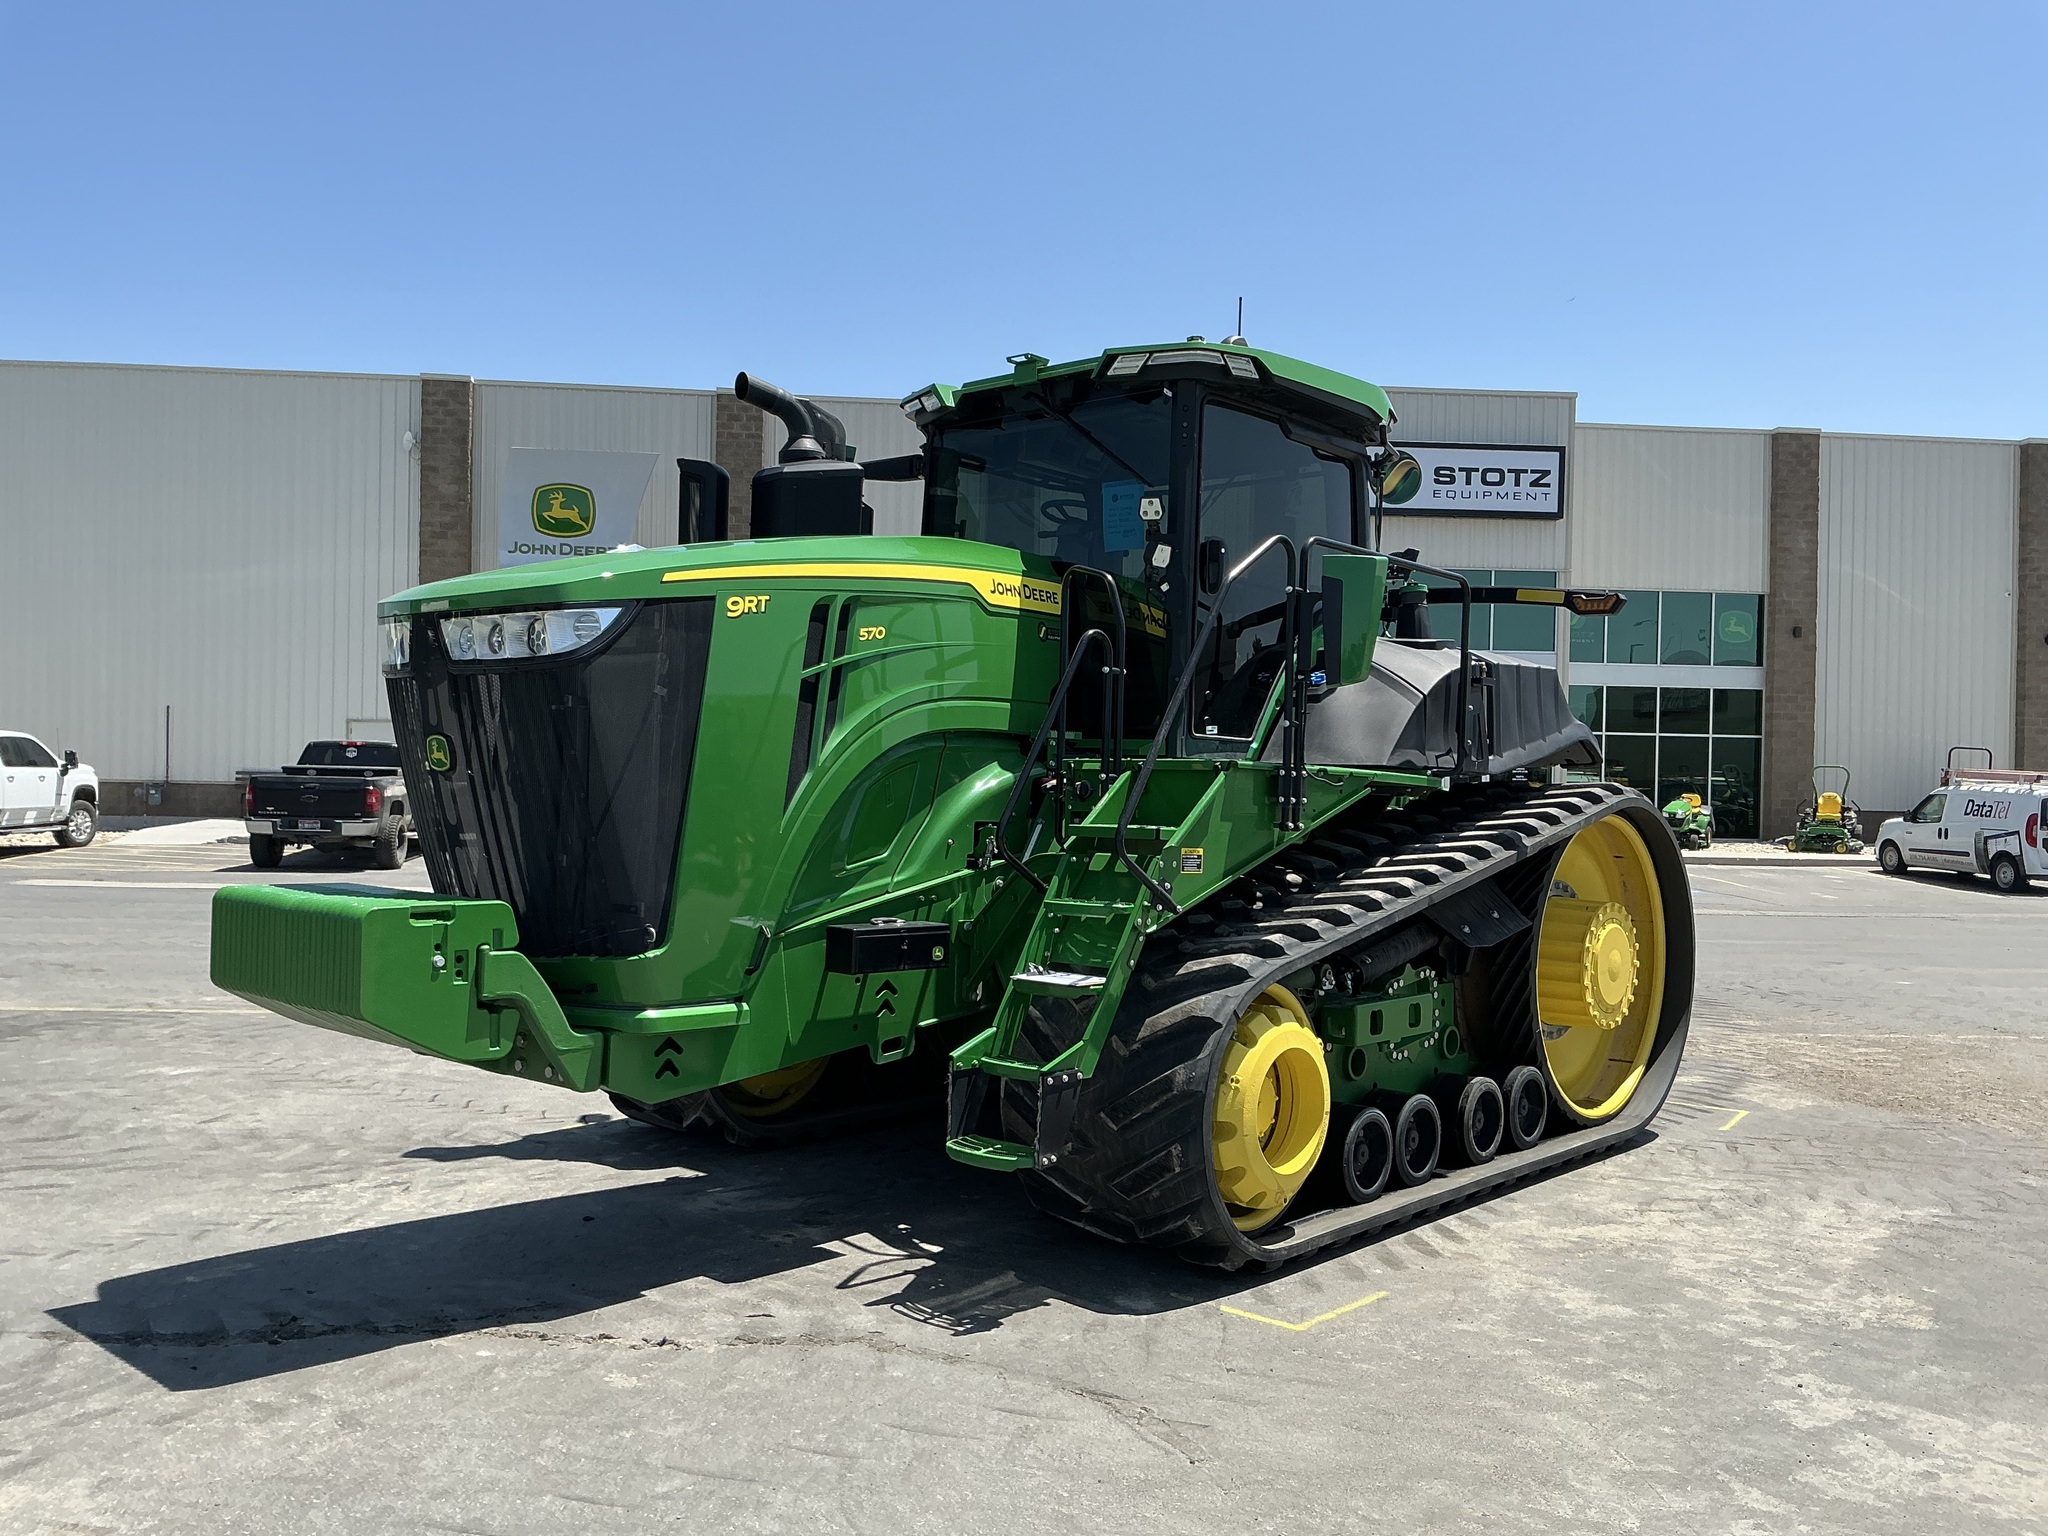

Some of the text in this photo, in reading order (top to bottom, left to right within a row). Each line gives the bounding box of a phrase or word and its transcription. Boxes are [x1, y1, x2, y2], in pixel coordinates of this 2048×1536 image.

[1433, 466, 1552, 488] STOTZ
[1432, 489, 1552, 502] EQUIPMENT
[508, 541, 557, 555] JOHN
[990, 578, 1060, 605] JOHN DEERE
[726, 595, 771, 619] 9RT
[859, 626, 887, 641] 570
[1964, 799, 2011, 819] DataTel
